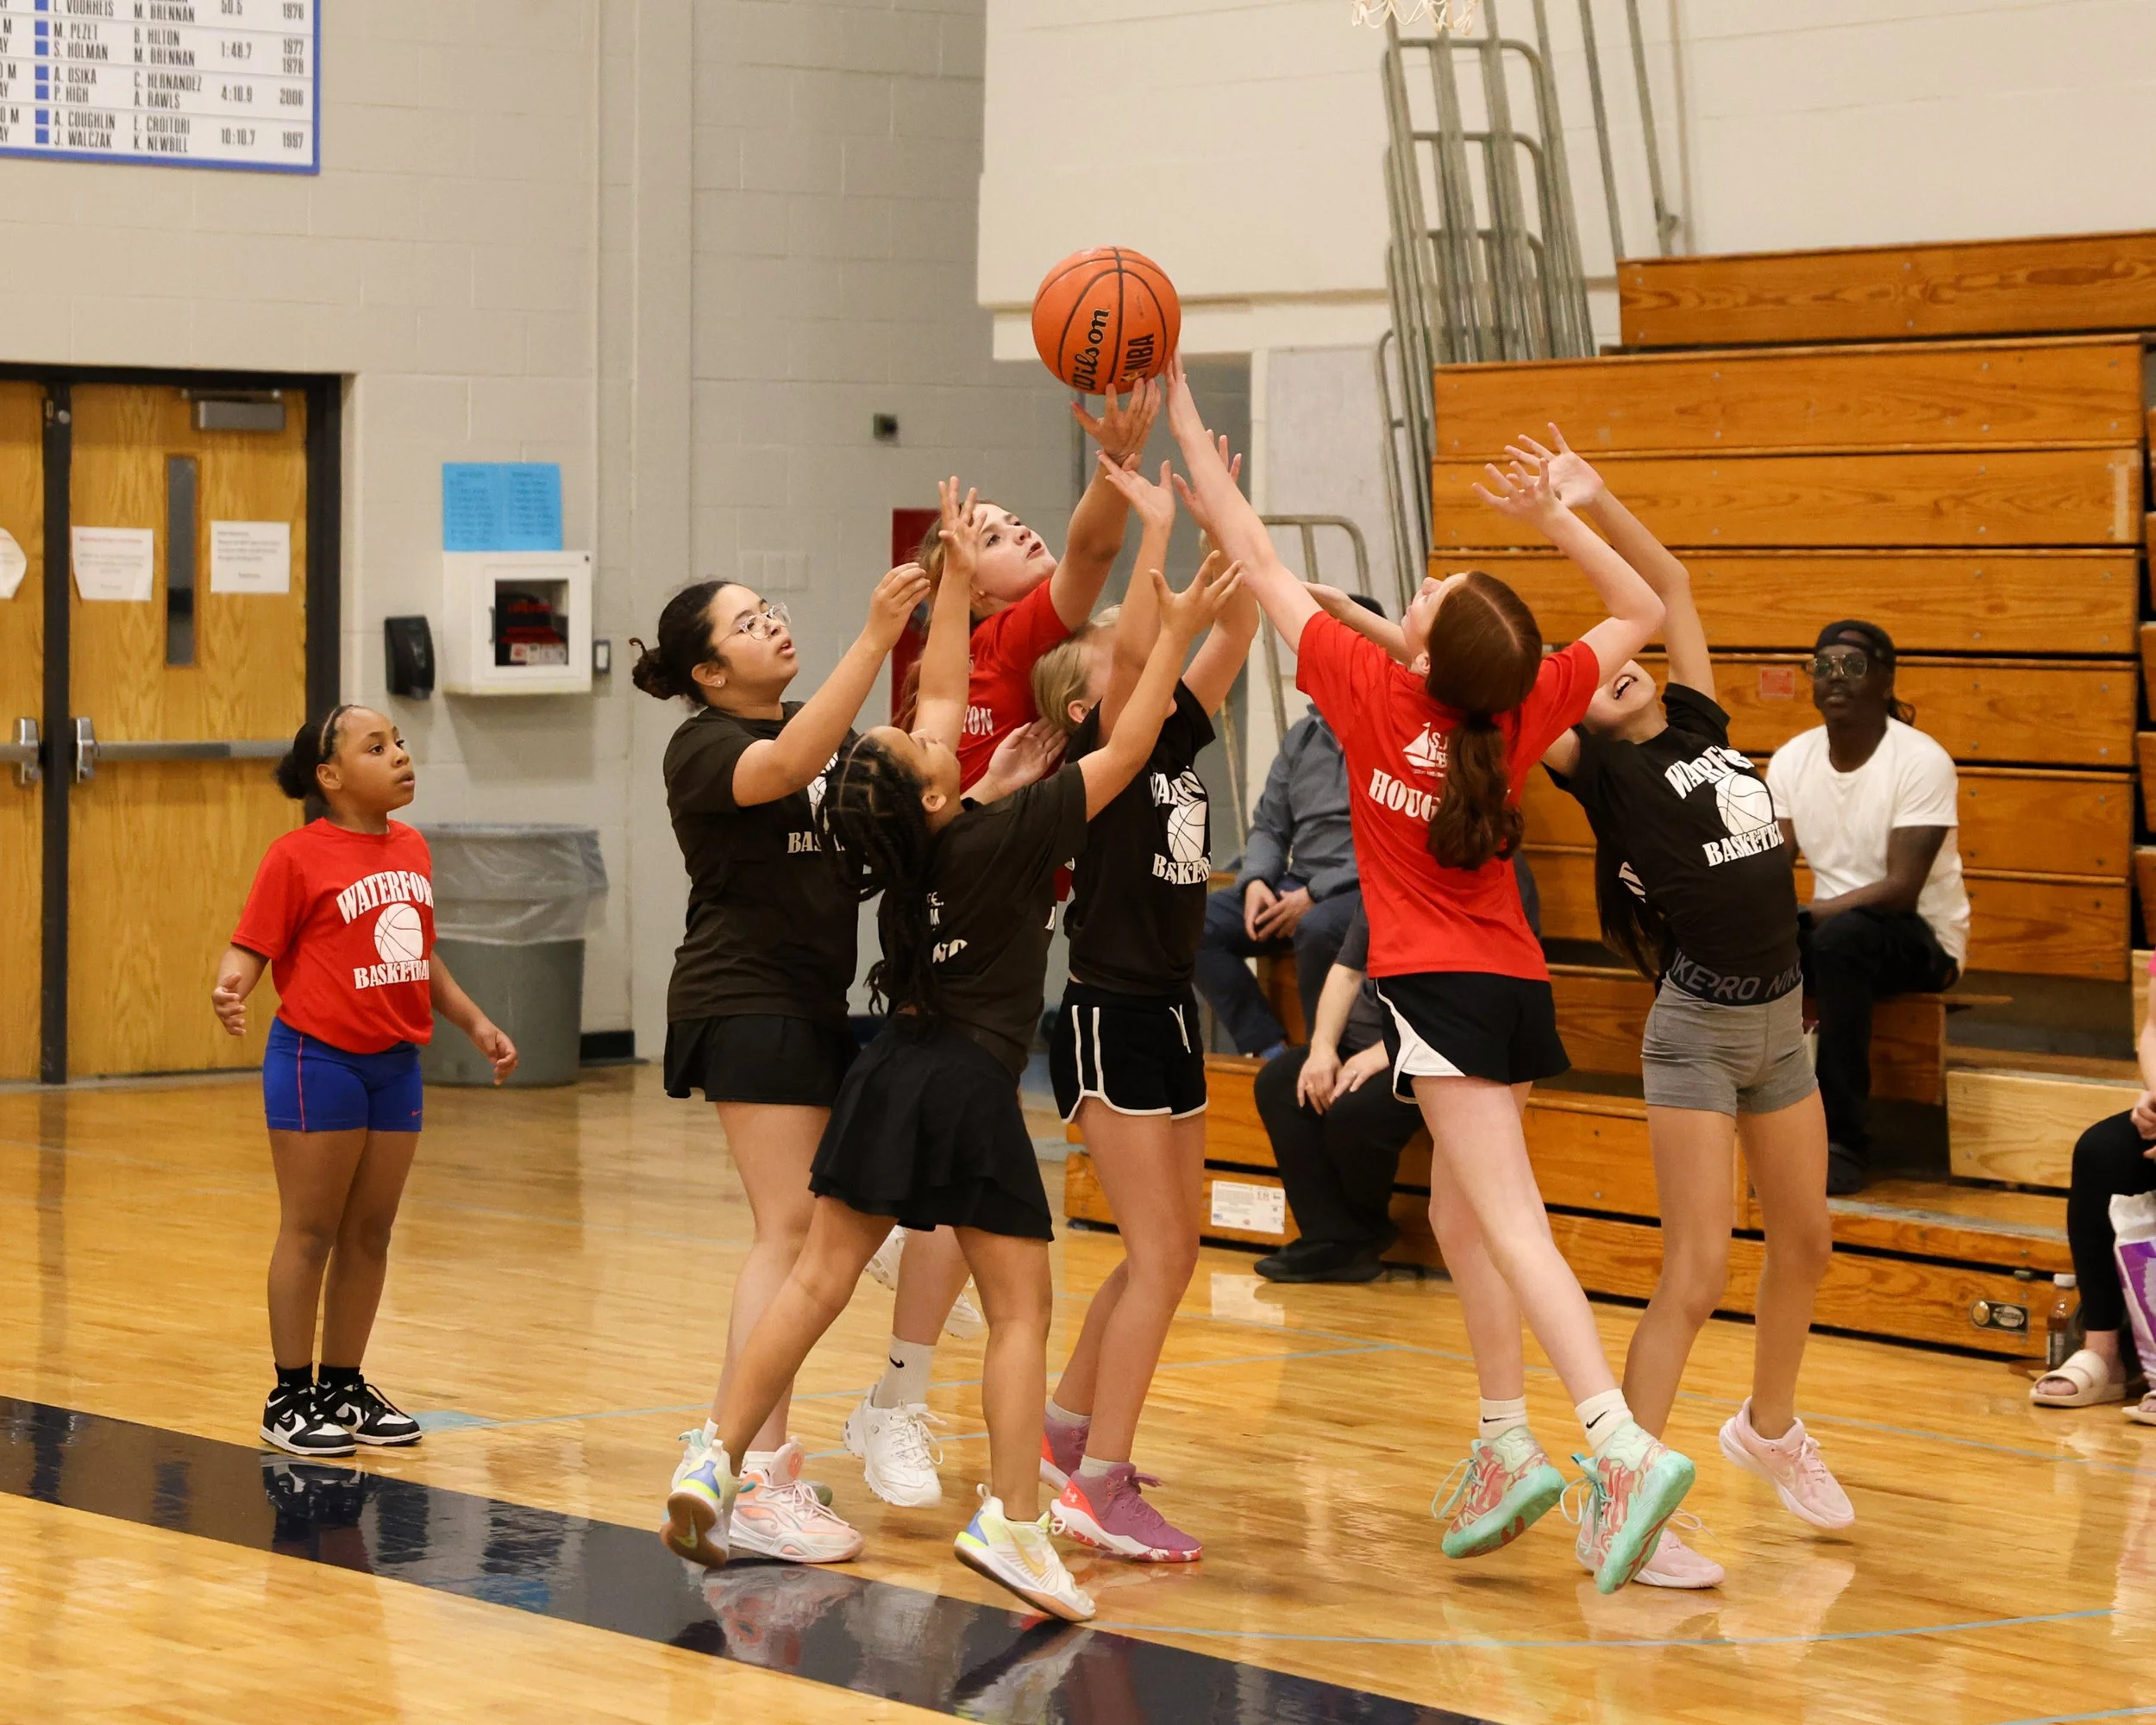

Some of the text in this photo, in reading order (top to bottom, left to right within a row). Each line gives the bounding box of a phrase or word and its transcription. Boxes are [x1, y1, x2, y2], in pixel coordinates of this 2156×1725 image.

[134, 3, 195, 22] M. BRENNAN
[53, 21, 66, 39] M.
[147, 28, 180, 47] HILTON
[53, 41, 108, 60] S. HOLMAN
[283, 38, 304, 55] 1977
[134, 47, 195, 67] M. BRENNAN
[53, 66, 97, 85] A. OSIKA
[147, 72, 202, 91] HERNANDEZ
[54, 84, 89, 103] P. HIGH
[134, 90, 180, 110] A. RAWLS
[54, 110, 116, 131] A. COUGHLIN
[147, 114, 190, 134] CROITORI
[54, 128, 112, 149] J. WALCZAK
[134, 134, 143, 150] K.
[221, 127, 256, 146] 10:10.7
[1072, 308, 1111, 392] Wilson
[1125, 333, 1155, 371] NBA
